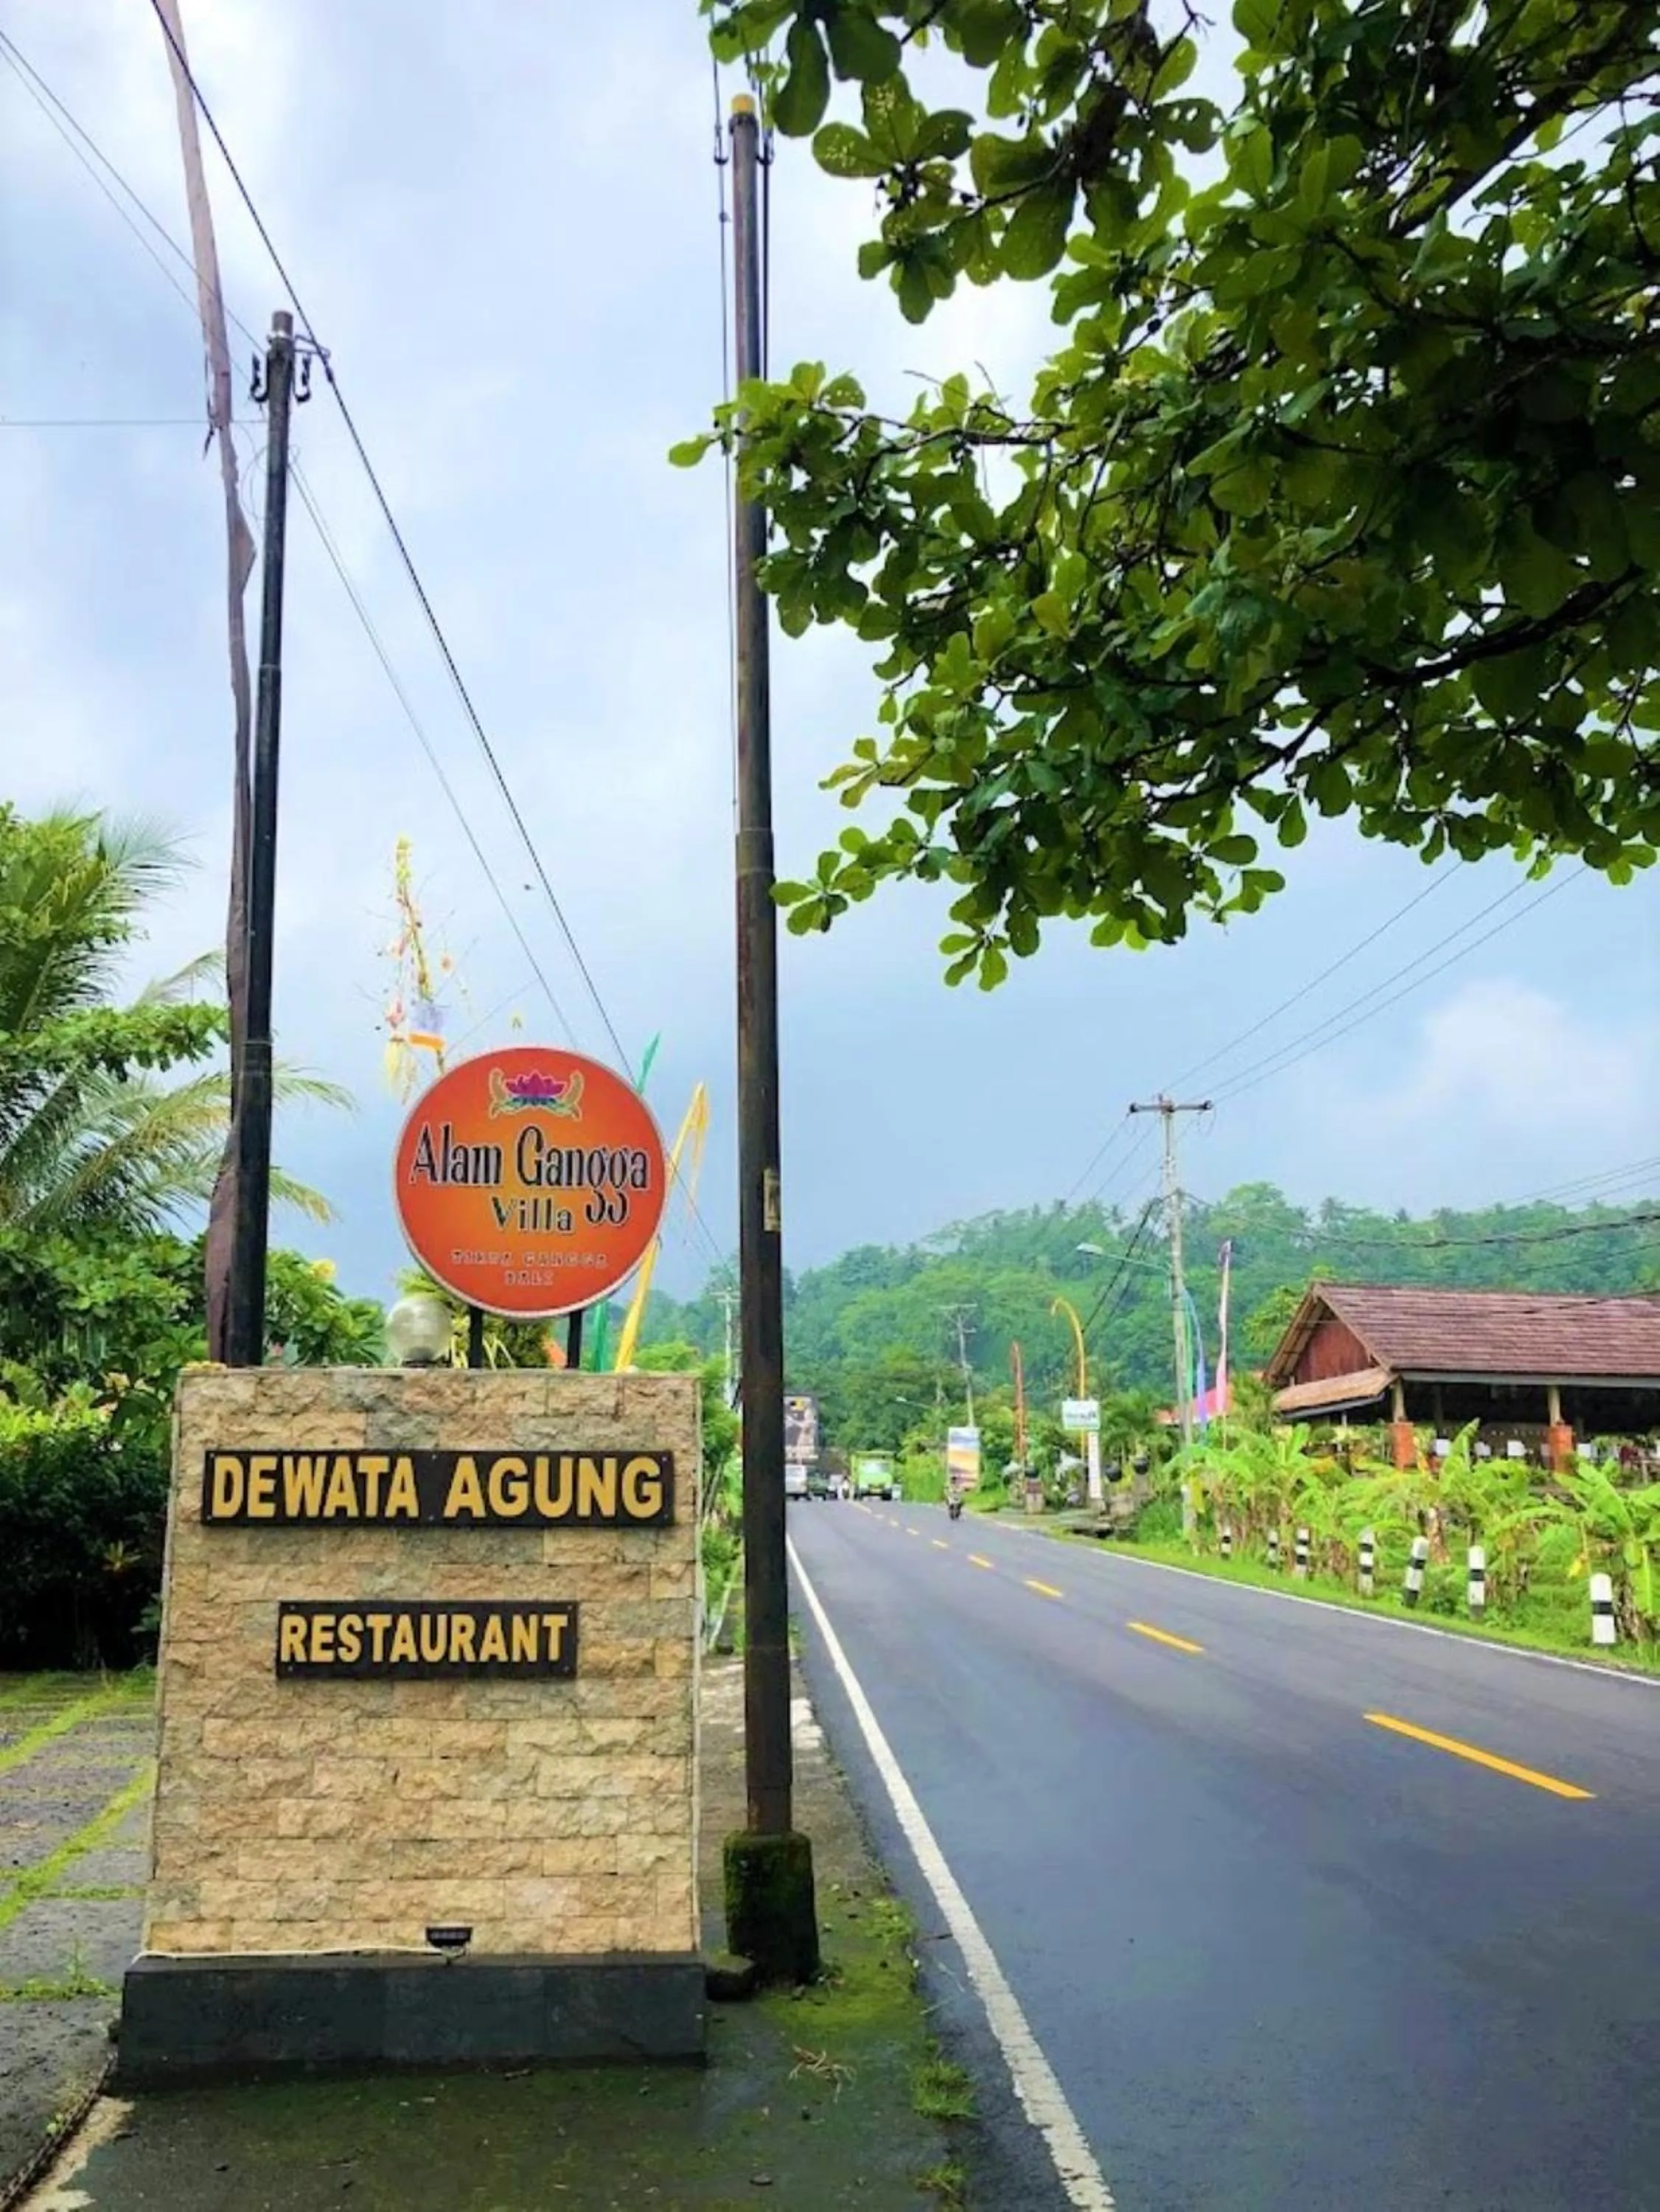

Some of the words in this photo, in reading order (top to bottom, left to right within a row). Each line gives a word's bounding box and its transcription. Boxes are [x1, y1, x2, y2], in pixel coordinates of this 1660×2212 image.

[410, 1123, 503, 1187] Alam
[516, 1124, 649, 1225] Gangga
[492, 1196, 573, 1232] Villa
[212, 1455, 419, 1518] DEWATA
[444, 1456, 662, 1519] AGUNG
[280, 1613, 568, 1663] RESTAURANT
